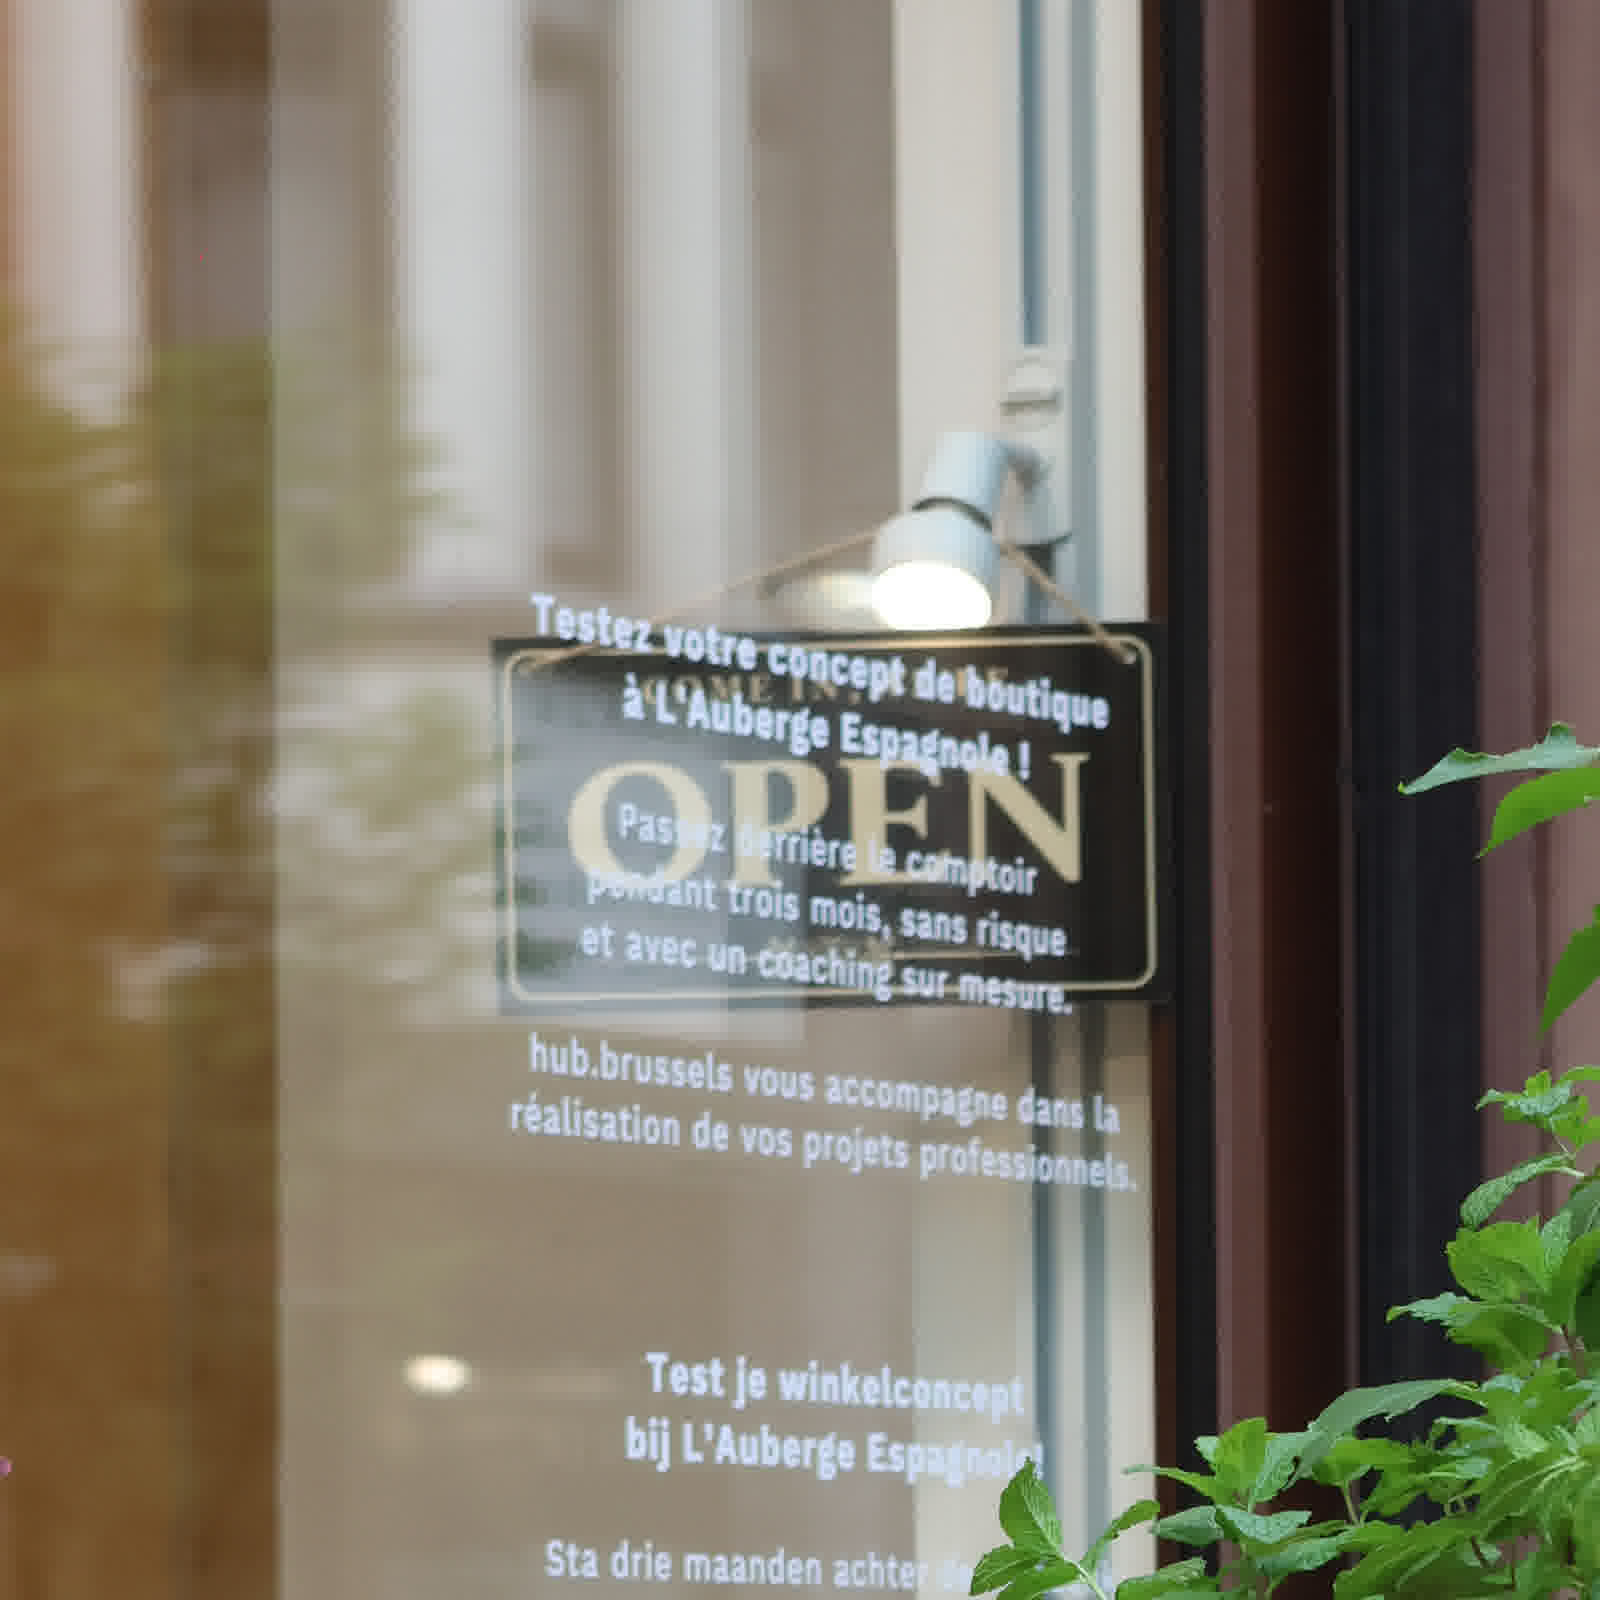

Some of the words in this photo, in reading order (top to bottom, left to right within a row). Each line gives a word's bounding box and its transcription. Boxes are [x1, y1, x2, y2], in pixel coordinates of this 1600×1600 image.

[531, 593, 653, 653] Testez
[664, 624, 756, 672] votre
[767, 640, 906, 699] concept
[915, 659, 955, 702] de
[966, 666, 1110, 735] boutique
[622, 673, 645, 721] à
[656, 683, 829, 756] L'Auberge
[840, 712, 1010, 779] Espagnole
[567, 751, 1091, 887] OPEN
[868, 839, 898, 875] le
[905, 850, 1038, 898] comptoir
[728, 877, 800, 923] trois
[810, 891, 891, 942] mois,
[901, 907, 967, 947] sans
[976, 910, 1066, 962] risque
[579, 922, 614, 958] et
[625, 931, 697, 970] avec
[708, 941, 746, 976] un
[759, 943, 893, 1003] coaching
[902, 966, 950, 1003] sur
[960, 976, 1073, 1016] mesure.
[528, 1031, 733, 1093] hub.brussels
[744, 1063, 815, 1102] vous
[824, 1072, 1009, 1129] accompagne
[1018, 1086, 1085, 1130] dans
[1093, 1095, 1121, 1135] la
[509, 1087, 681, 1149] réalisation
[691, 1111, 730, 1153] de
[739, 1123, 793, 1159] vos
[802, 1127, 909, 1174] projets
[919, 1138, 1138, 1194] professionnels.
[645, 1351, 726, 1399] Test
[734, 1355, 768, 1411] je
[779, 1359, 1026, 1426] winkelconcept
[623, 1415, 671, 1473] bij
[682, 1421, 857, 1479] L'Auberge
[544, 1538, 599, 1579] Sta
[608, 1539, 674, 1582] drie
[682, 1546, 823, 1588] maanden
[832, 1550, 929, 1592] achter
